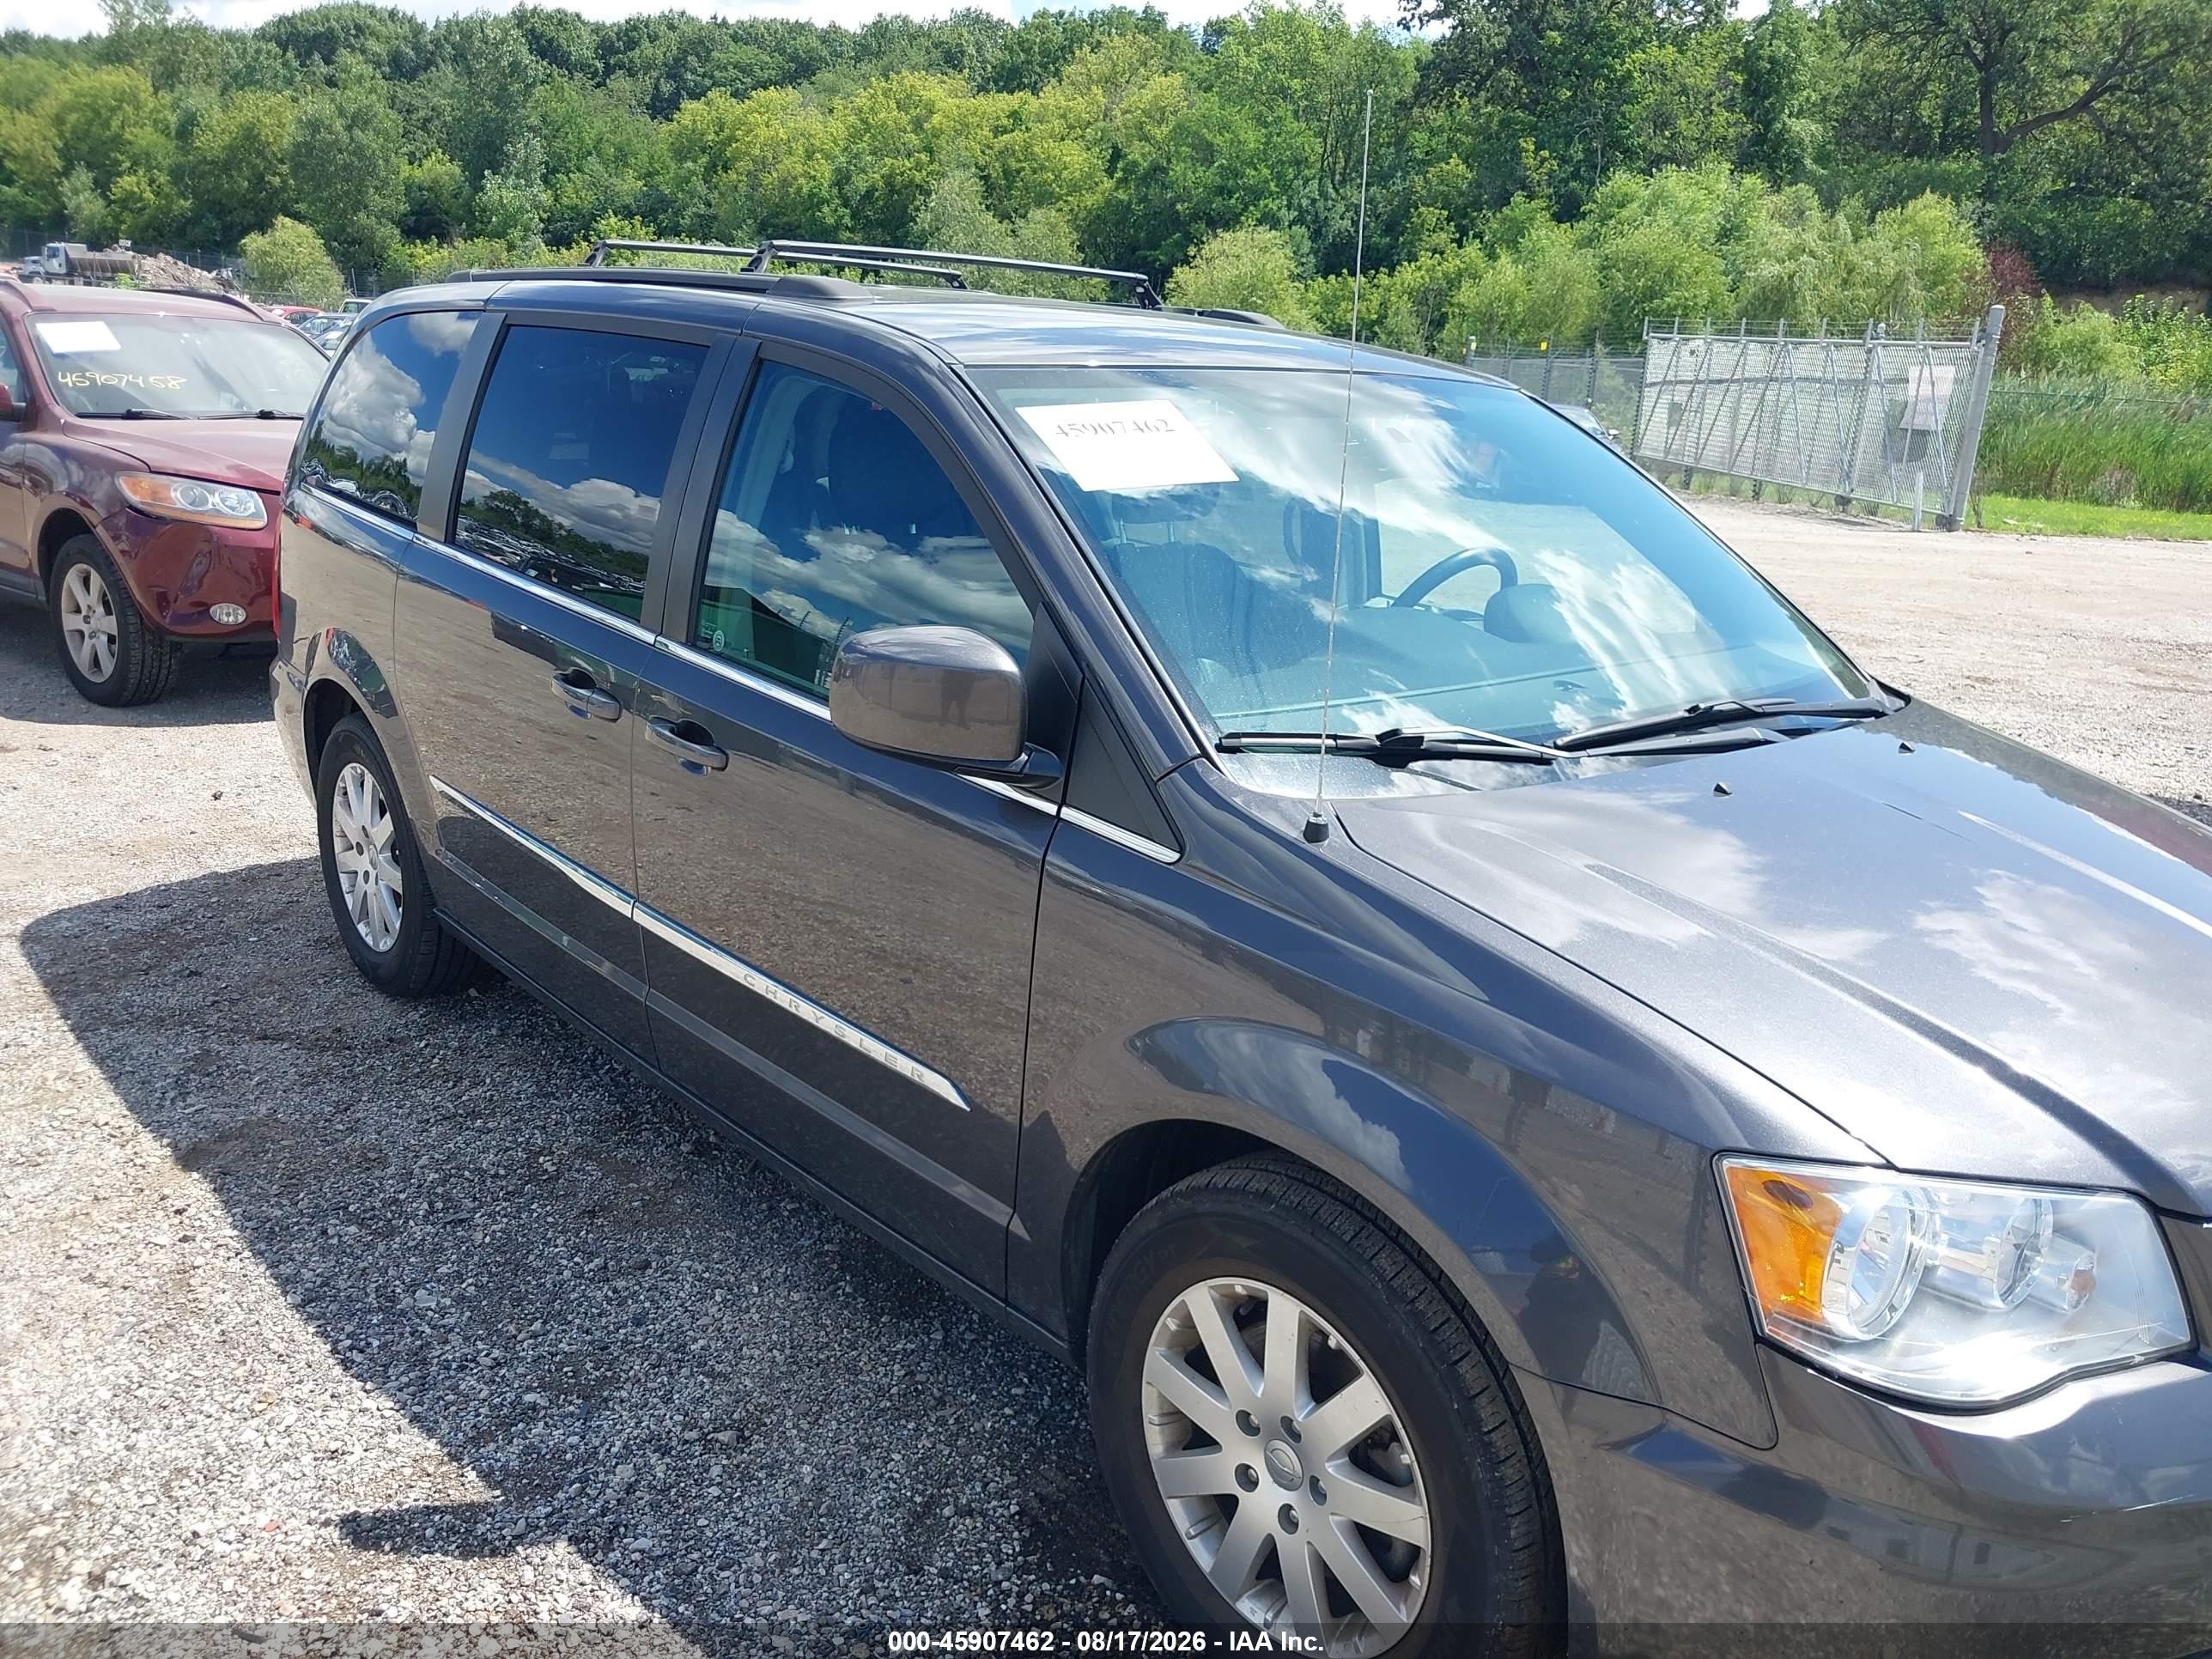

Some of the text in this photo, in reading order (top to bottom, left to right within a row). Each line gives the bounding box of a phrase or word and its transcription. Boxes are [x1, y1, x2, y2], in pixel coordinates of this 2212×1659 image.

[58, 371, 188, 390] 45907458
[1055, 418, 1176, 438] 45907462
[743, 972, 927, 1083] CHRYSLER
